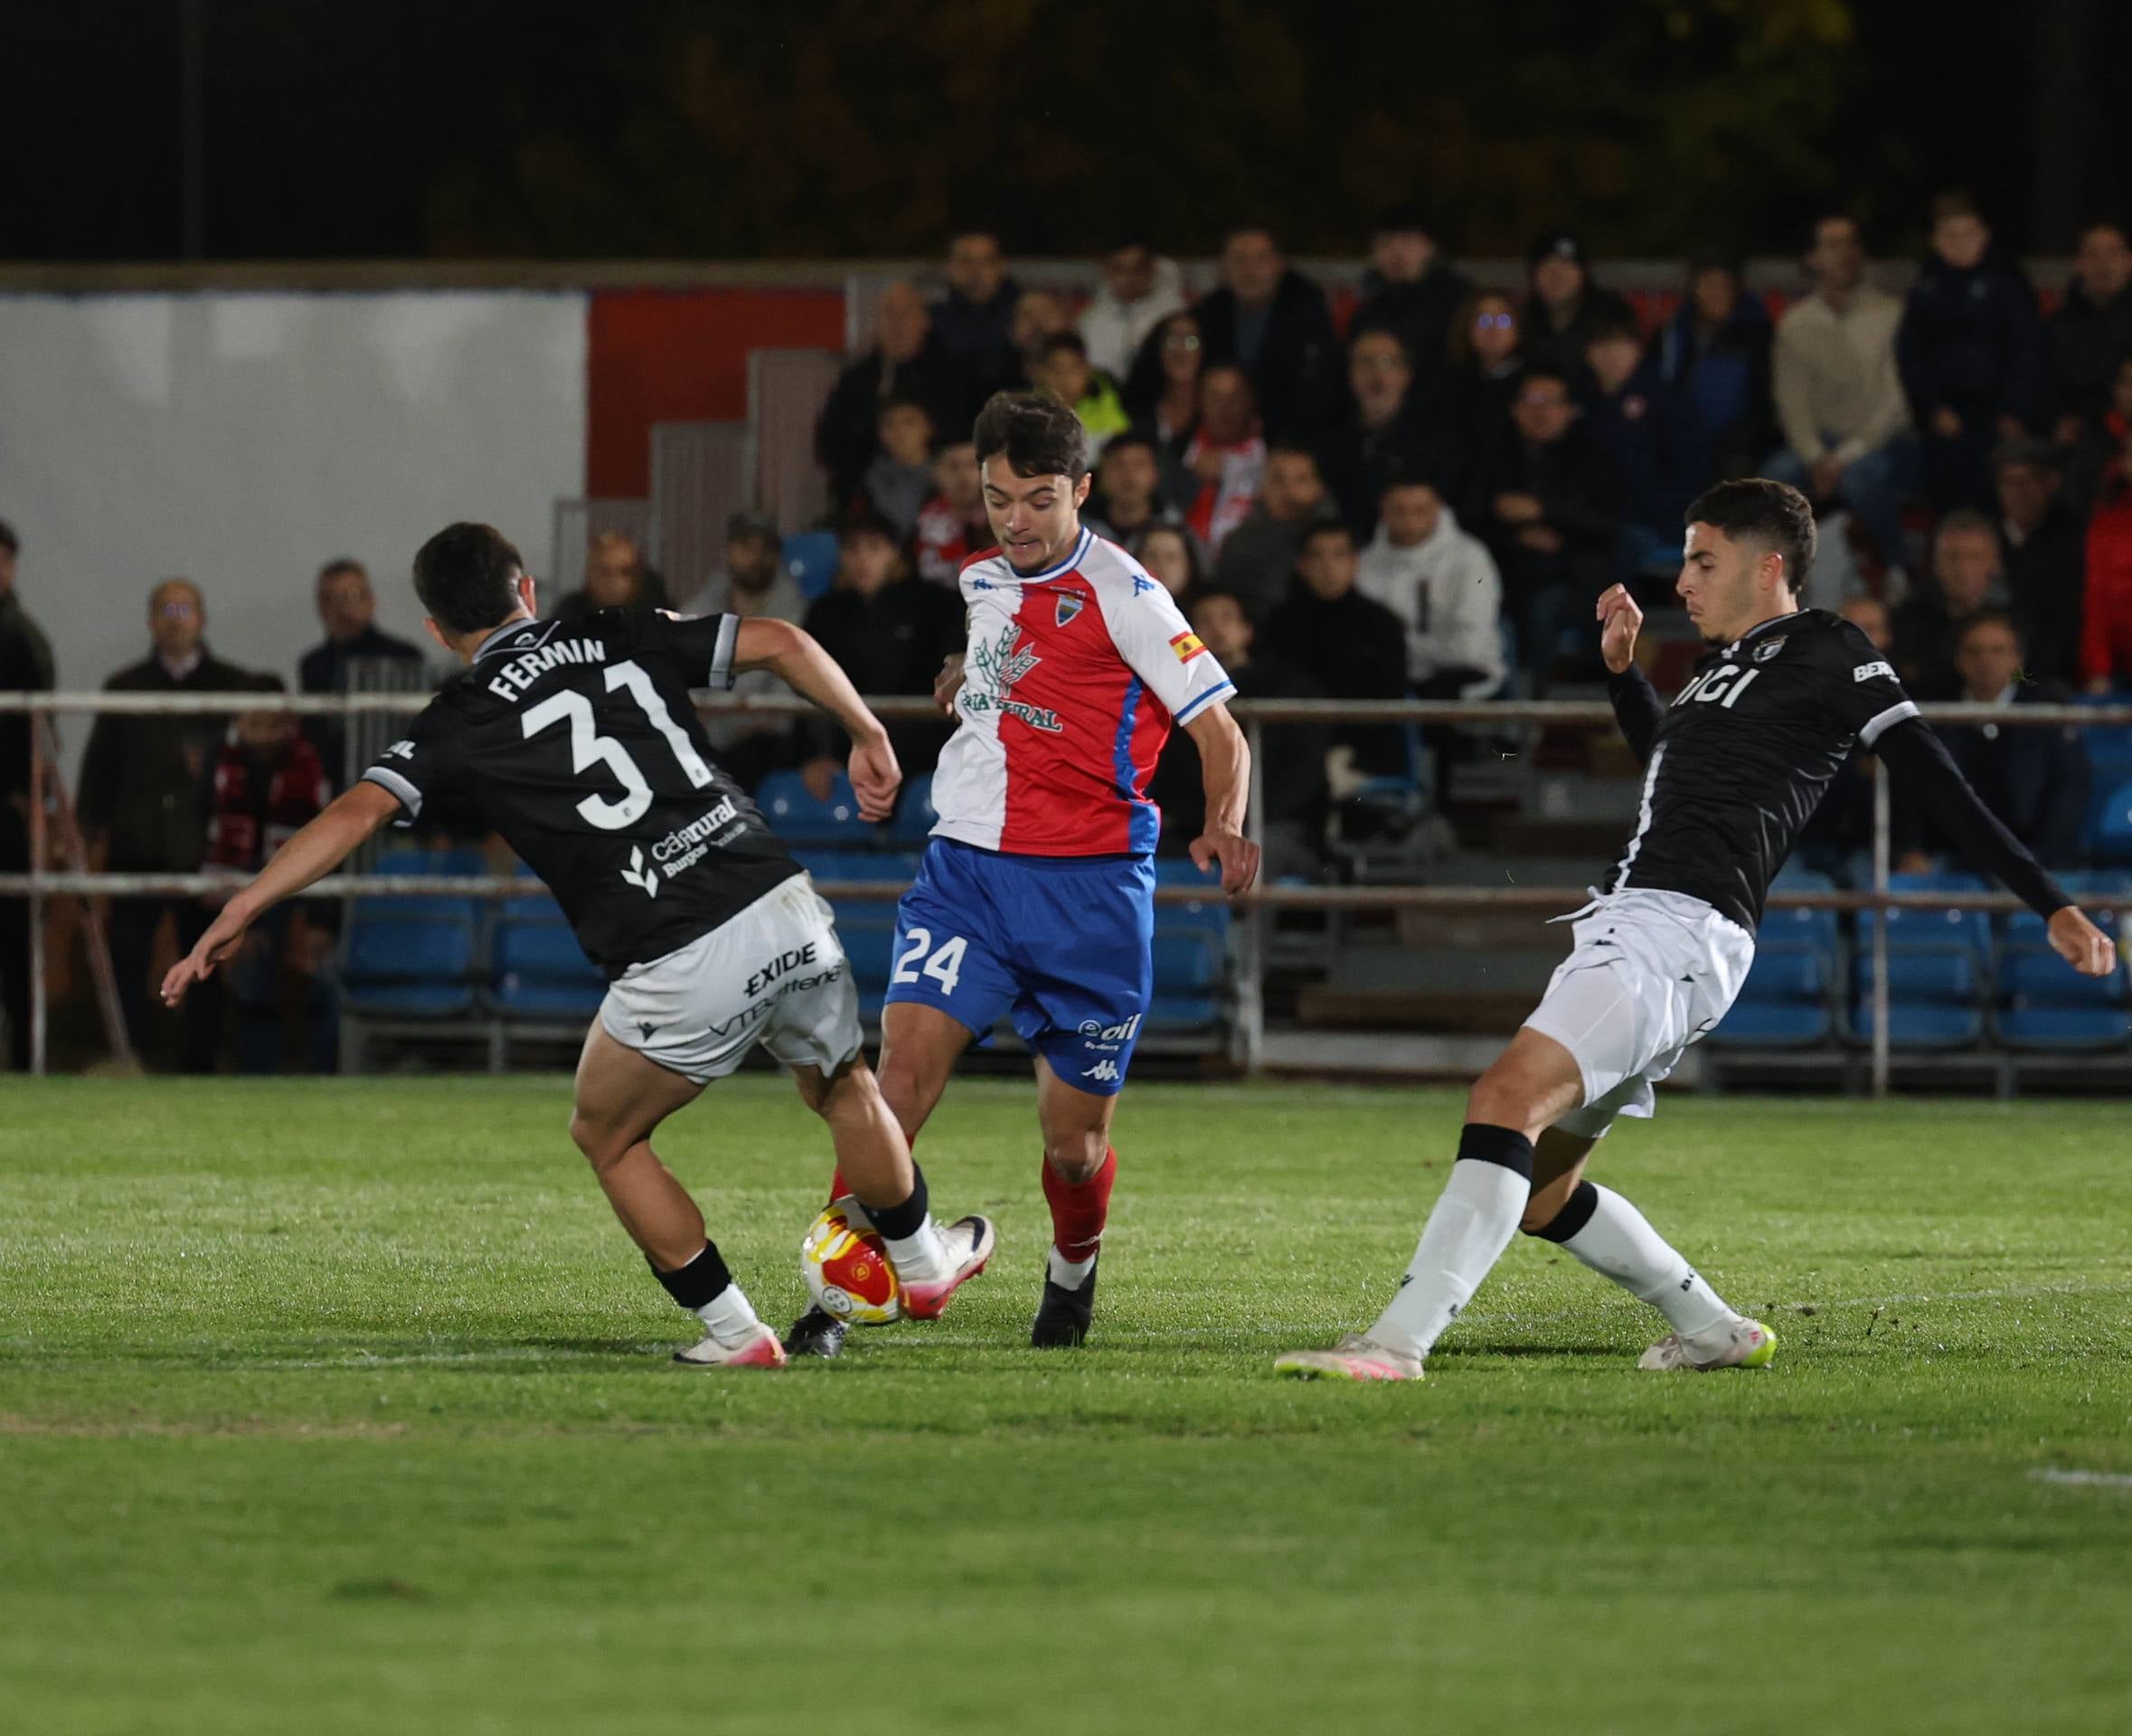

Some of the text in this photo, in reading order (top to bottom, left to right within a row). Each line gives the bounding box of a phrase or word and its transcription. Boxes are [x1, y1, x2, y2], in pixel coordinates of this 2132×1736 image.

[487, 638, 607, 703] FERMIN
[521, 660, 714, 830] 31
[744, 941, 816, 998] EXIDE
[893, 928, 967, 995] 24
